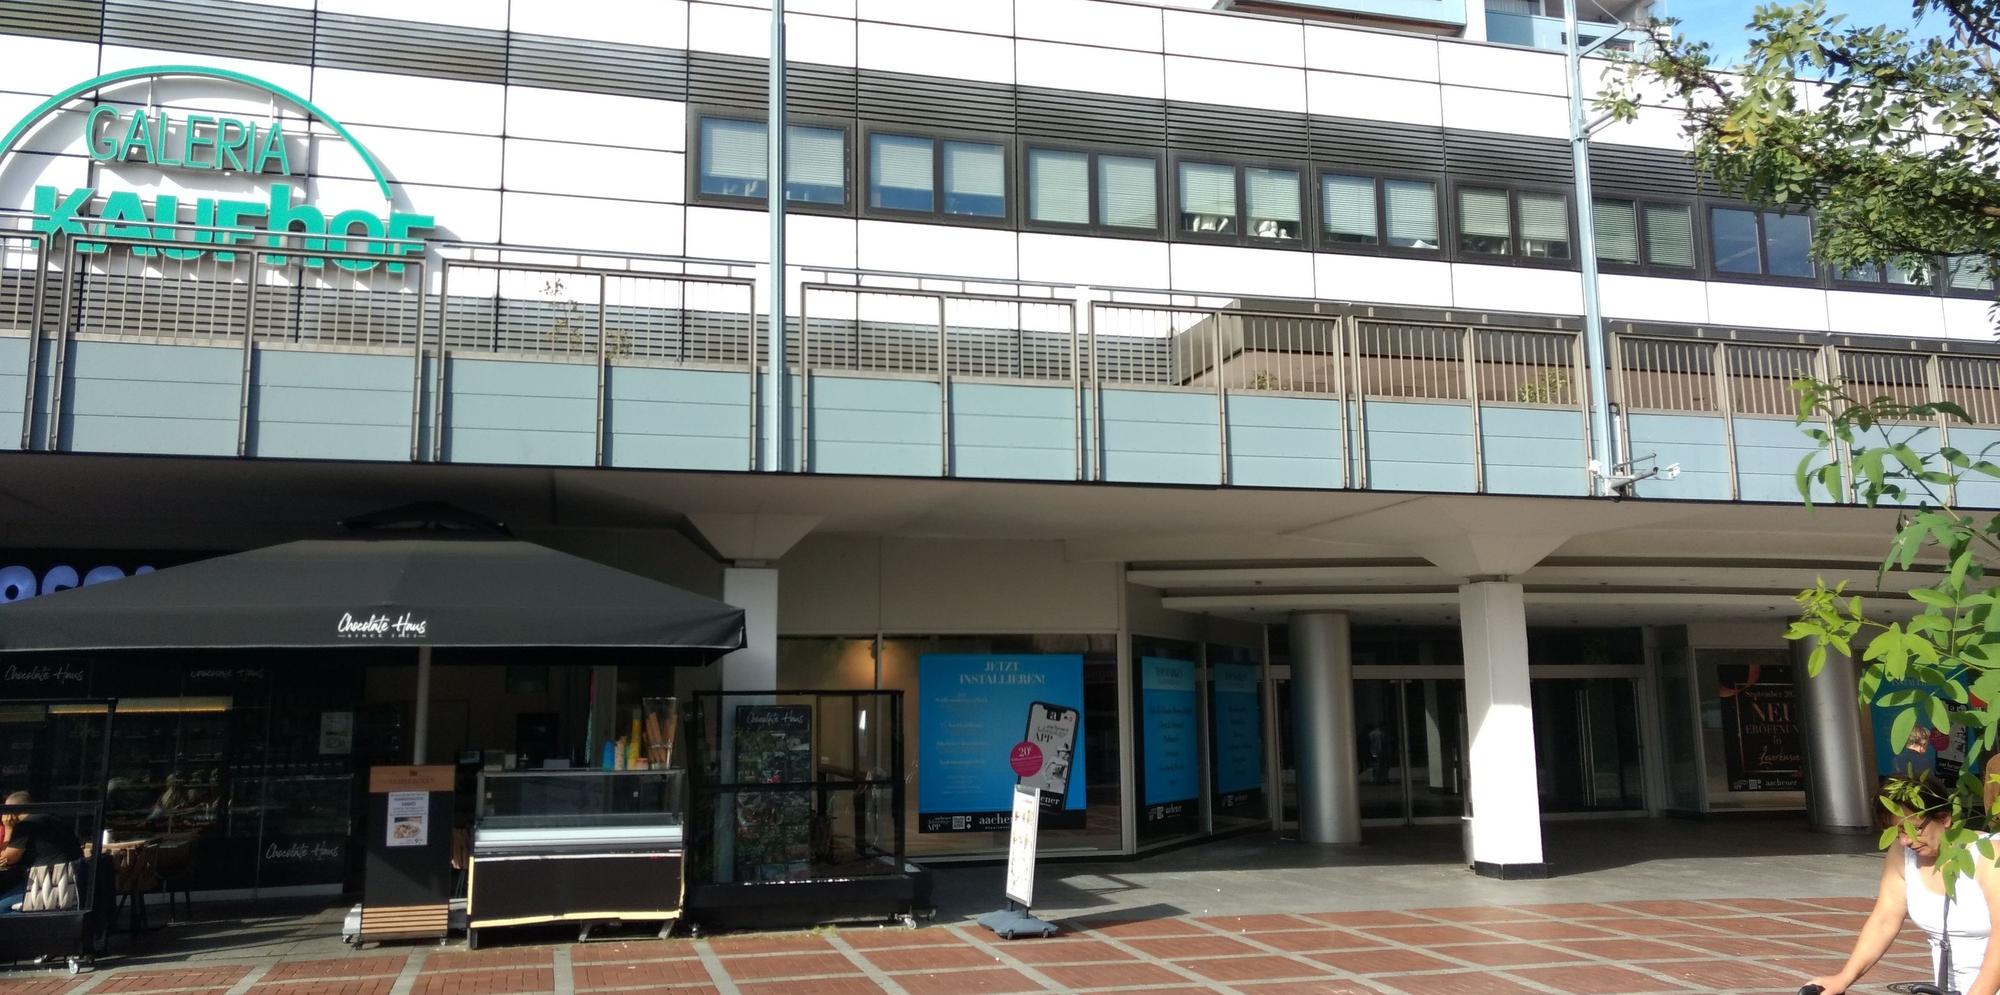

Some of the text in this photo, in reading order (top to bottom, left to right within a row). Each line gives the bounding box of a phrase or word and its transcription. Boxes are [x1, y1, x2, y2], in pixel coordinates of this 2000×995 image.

[85, 104, 291, 176] GALERIA
[337, 611, 427, 638] Chocolate Haus
[4, 664, 84, 685] Chocolate Haus
[984, 661, 1021, 673] JETZT
[959, 673, 1046, 686] INSTALLIEREN!
[978, 813, 1012, 825] aache
[265, 840, 340, 861] Chocolate Haus
